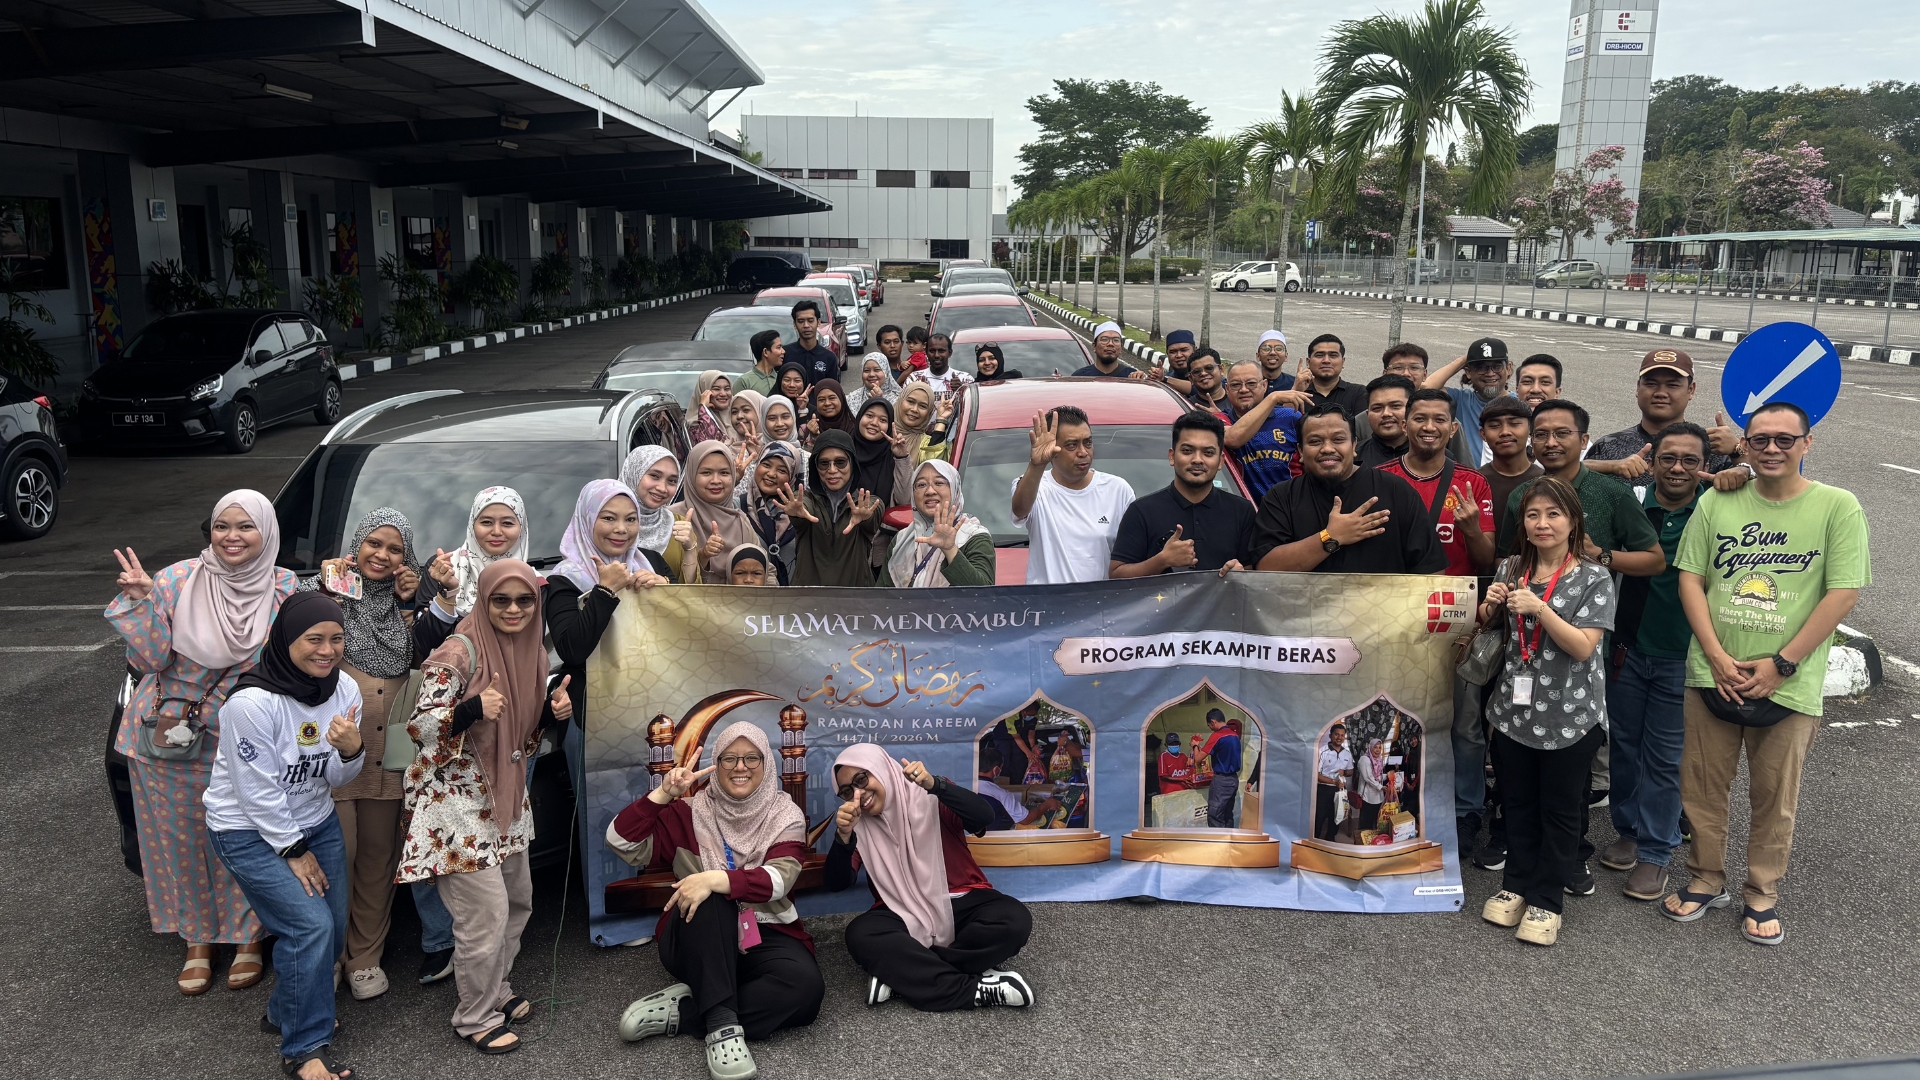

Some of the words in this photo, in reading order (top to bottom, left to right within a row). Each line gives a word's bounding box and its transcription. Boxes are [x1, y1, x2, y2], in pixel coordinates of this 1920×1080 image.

[1654, 351, 1677, 362] S
[125, 415, 139, 423] QLF
[141, 415, 154, 423] 134
[1242, 450, 1290, 464] MALAYSIA
[1741, 522, 1788, 547] Bum
[1713, 532, 1821, 579] Equipment
[1780, 591, 1800, 600] MITE
[1442, 610, 1467, 618] CTRM
[1718, 615, 1737, 625] Things
[1719, 606, 1743, 617] Where
[1745, 610, 1762, 620] The
[1765, 613, 1787, 624] Wild
[743, 612, 865, 638] SELAMAT
[870, 607, 1046, 634] MENYAMBUT
[1080, 642, 1175, 663] PROGRAM
[1181, 640, 1272, 660] SEKAMPIT
[1277, 646, 1337, 663] BERAS
[817, 717, 904, 729] RAMADAN
[911, 717, 978, 729] KAREEM
[836, 733, 864, 743] 1447
[868, 732, 879, 743] H
[891, 733, 923, 742] 2026
[926, 733, 940, 743] M
